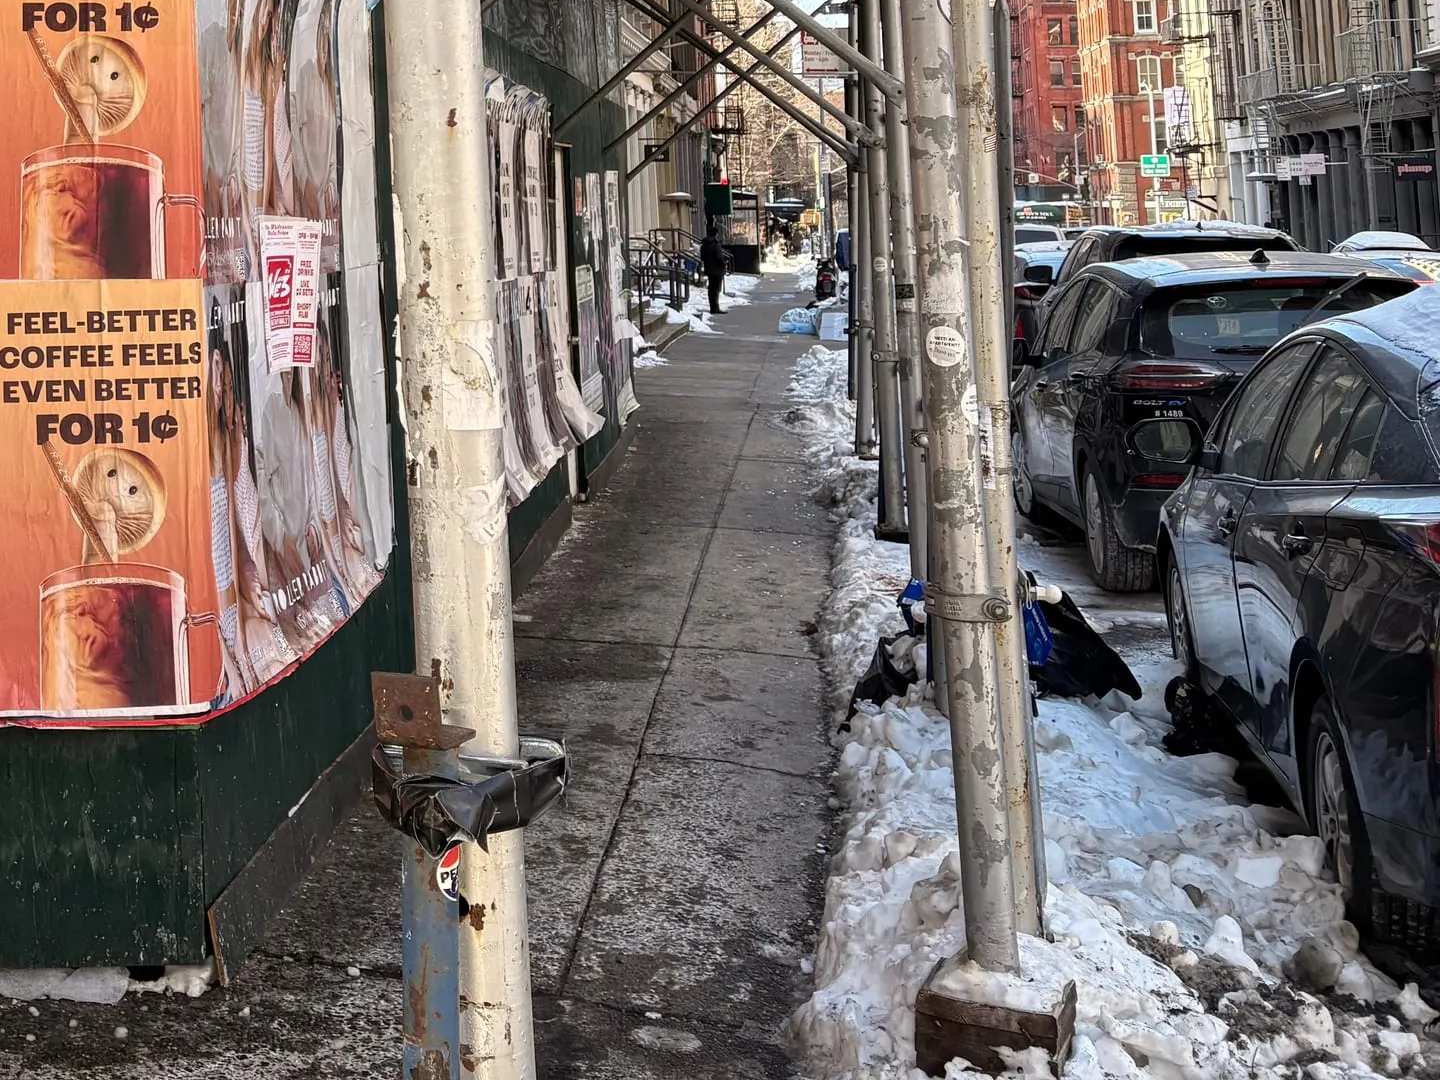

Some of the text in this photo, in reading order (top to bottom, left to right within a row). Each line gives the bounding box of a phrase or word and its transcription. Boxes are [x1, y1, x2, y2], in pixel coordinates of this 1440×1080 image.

[21, 0, 160, 34] FOR 1¢
[1397, 163, 1433, 177] plump
[7, 308, 198, 335] FEEL-BETTER
[121, 342, 202, 366] FEELS
[2, 376, 202, 404] EVEN BETTER
[35, 409, 179, 446] FOR 1¢
